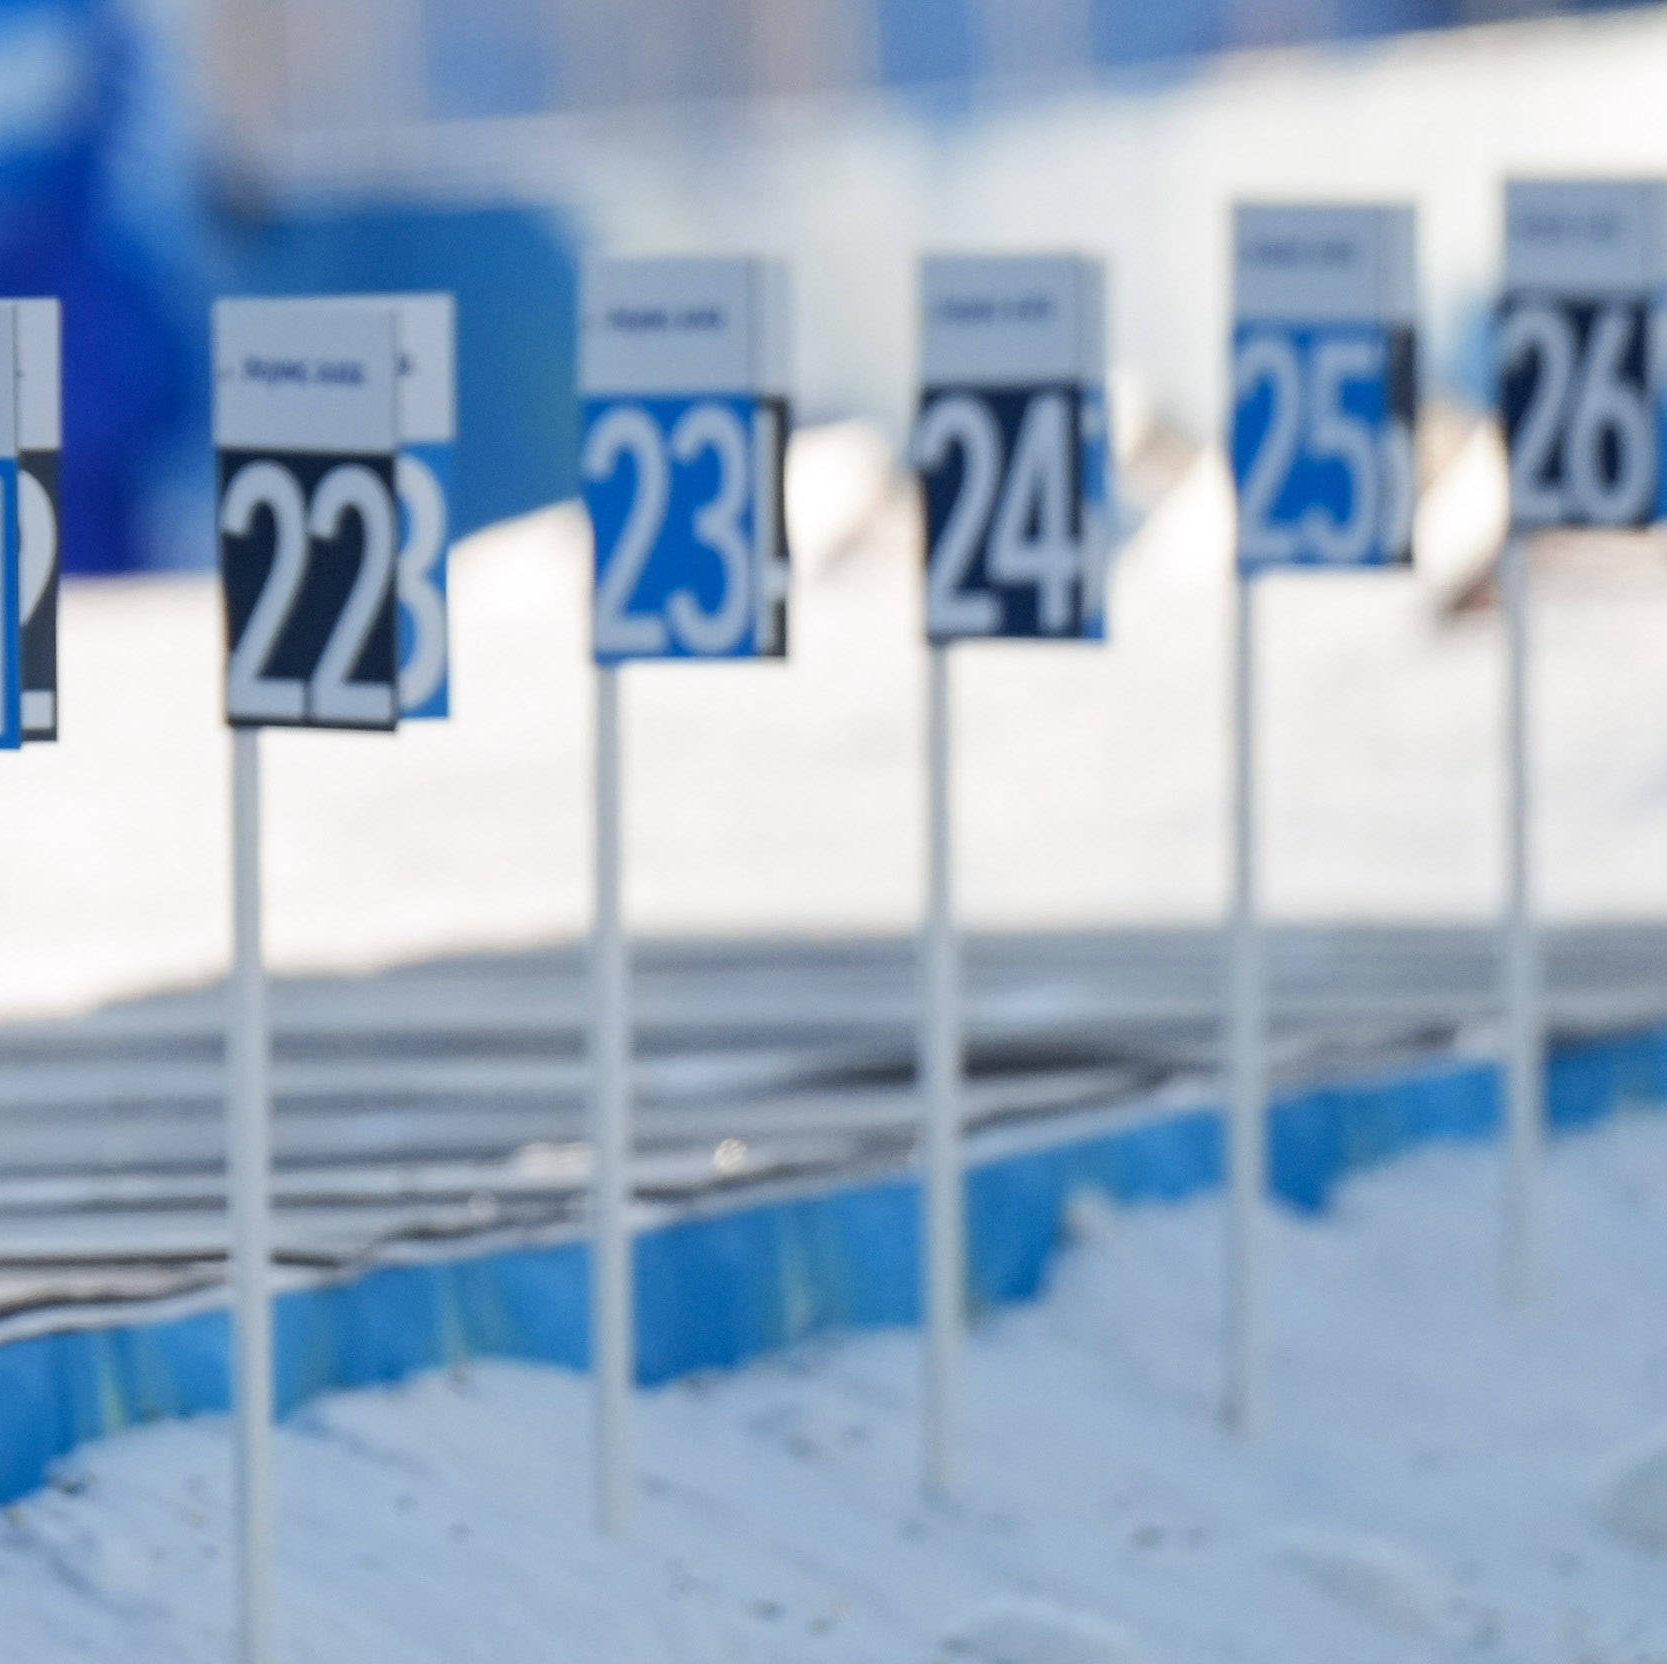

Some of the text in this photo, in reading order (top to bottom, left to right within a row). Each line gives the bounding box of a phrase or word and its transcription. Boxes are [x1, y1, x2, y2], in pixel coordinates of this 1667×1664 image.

[583, 402, 750, 655] 23
[911, 394, 1080, 632] 24
[1234, 339, 1380, 562] 25
[1499, 302, 1655, 526] 26
[220, 458, 396, 724] 22
